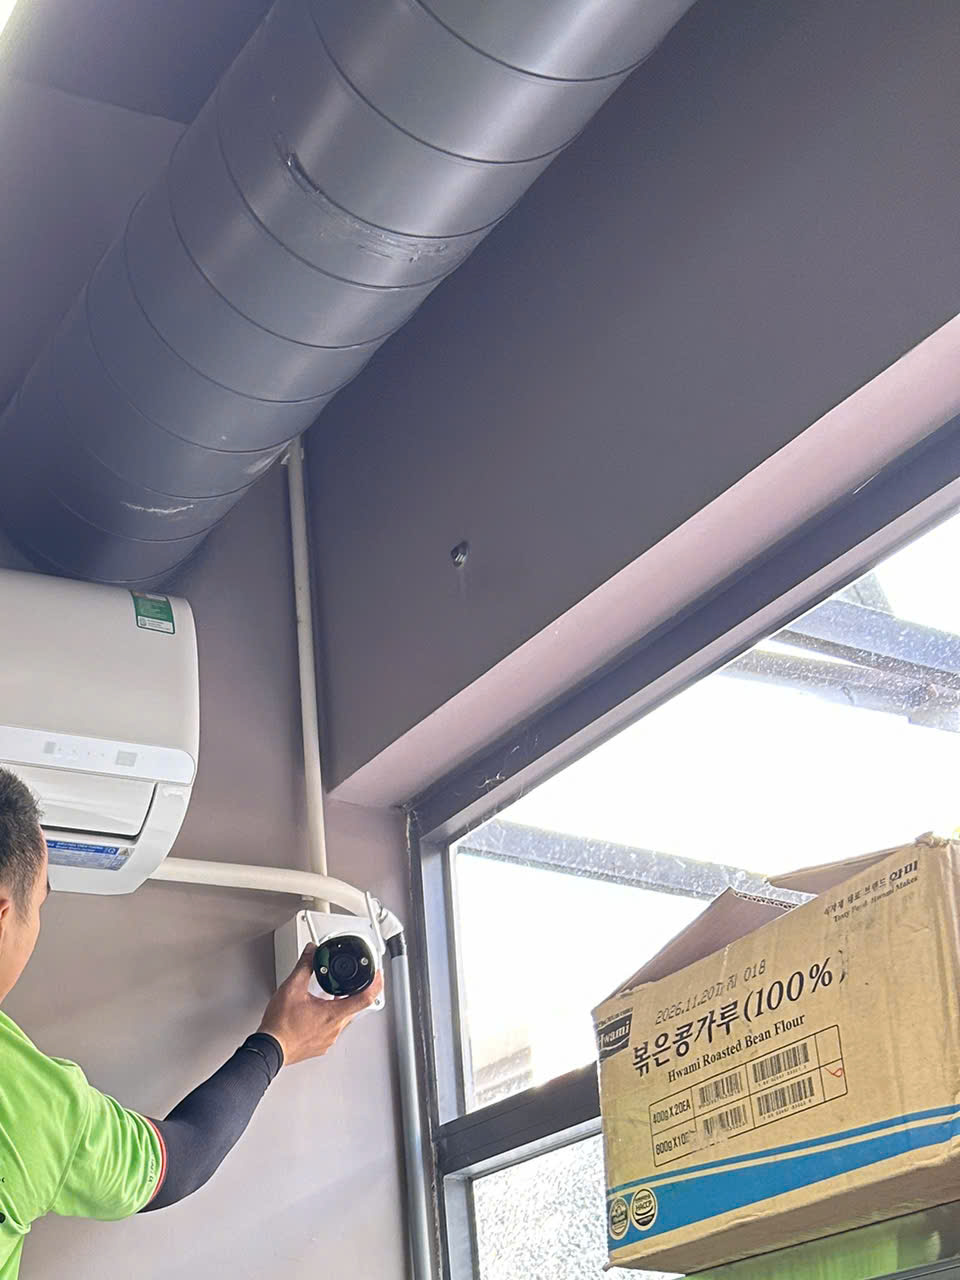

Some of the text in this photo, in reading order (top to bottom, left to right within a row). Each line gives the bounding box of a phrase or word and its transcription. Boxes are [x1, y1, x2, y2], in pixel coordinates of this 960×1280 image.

[743, 959, 767, 983] 018
[668, 1014, 806, 1083] Hwami Roasted Bean Flour
